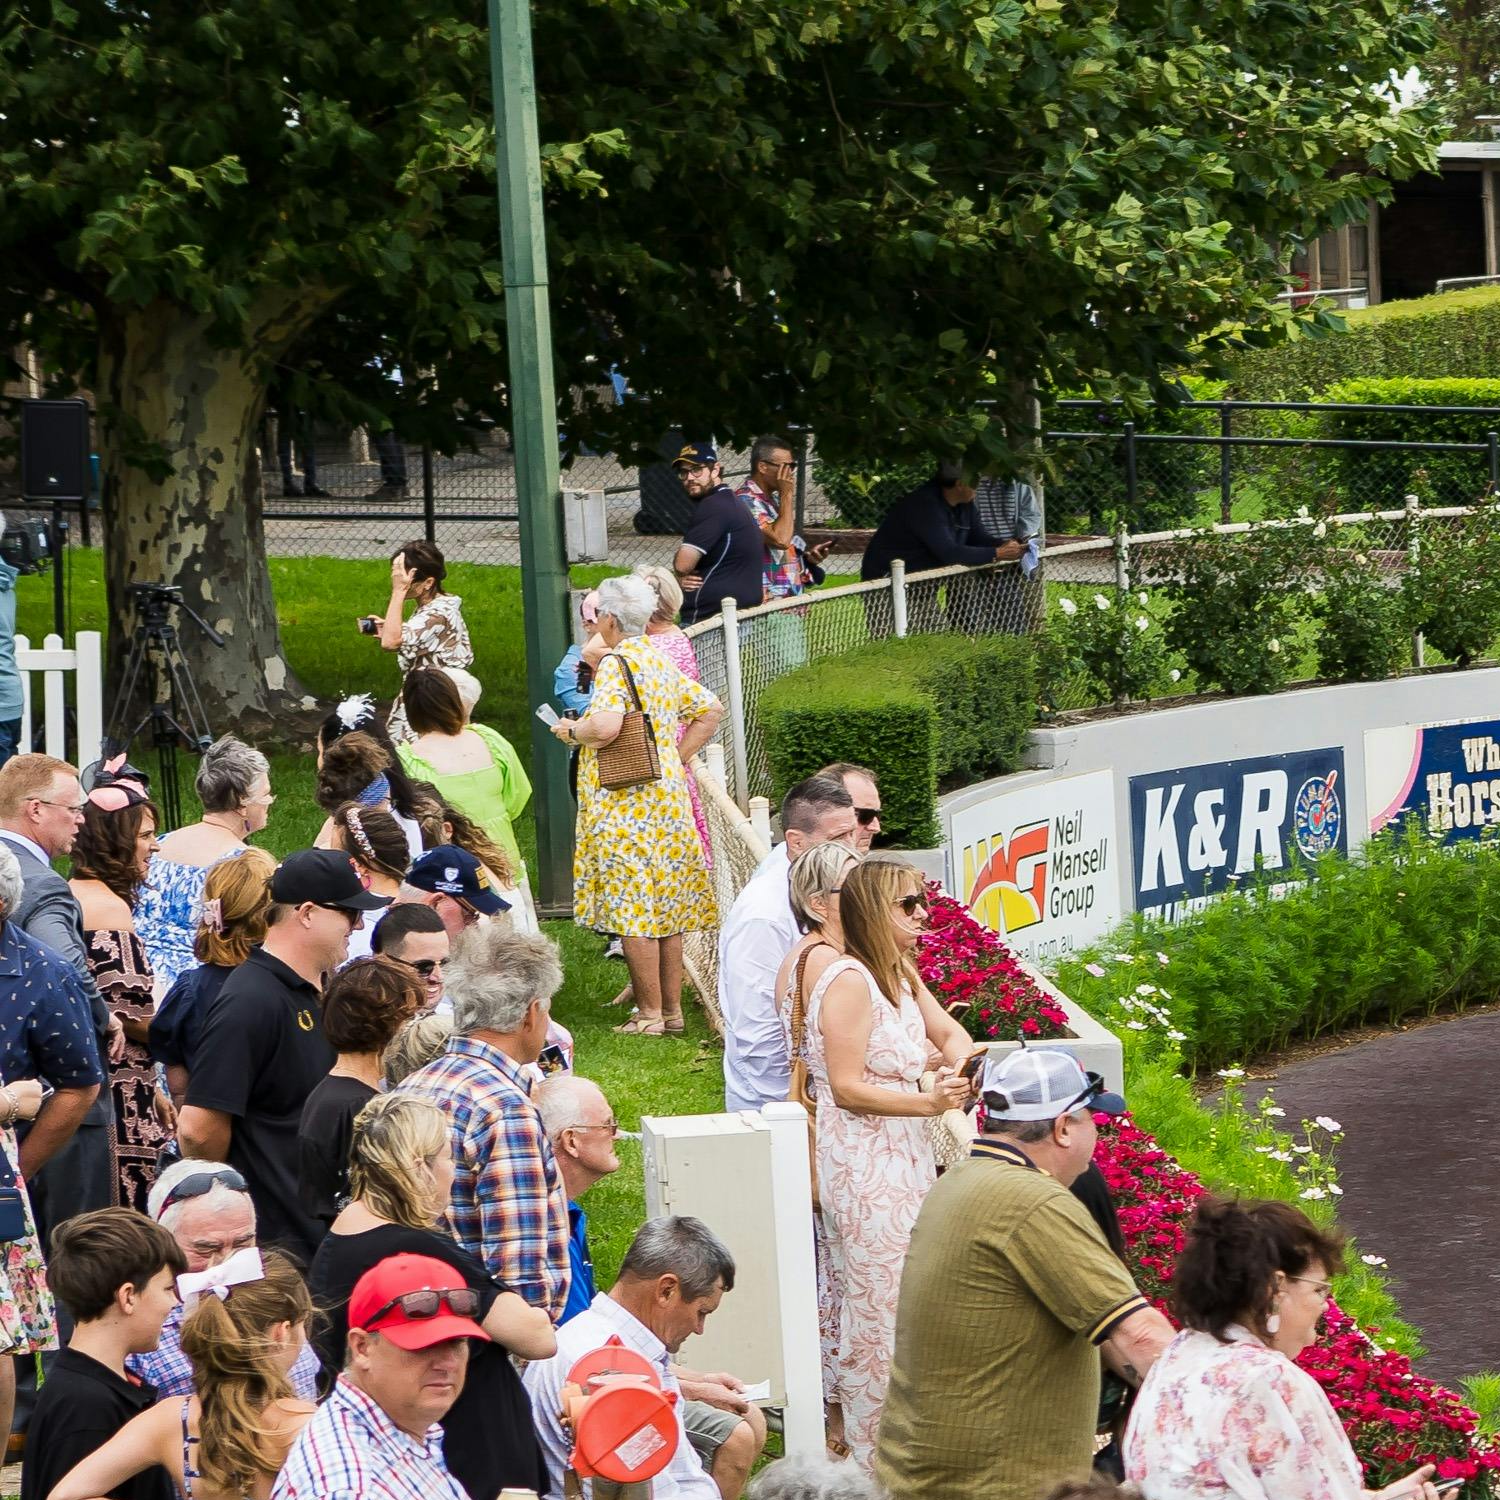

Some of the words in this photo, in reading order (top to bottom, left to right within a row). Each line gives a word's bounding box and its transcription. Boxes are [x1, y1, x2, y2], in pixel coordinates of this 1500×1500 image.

[1054, 809, 1083, 849] Neil
[1140, 769, 1288, 893] K&R
[1052, 838, 1108, 883] Mansell
[1050, 884, 1095, 918] Group
